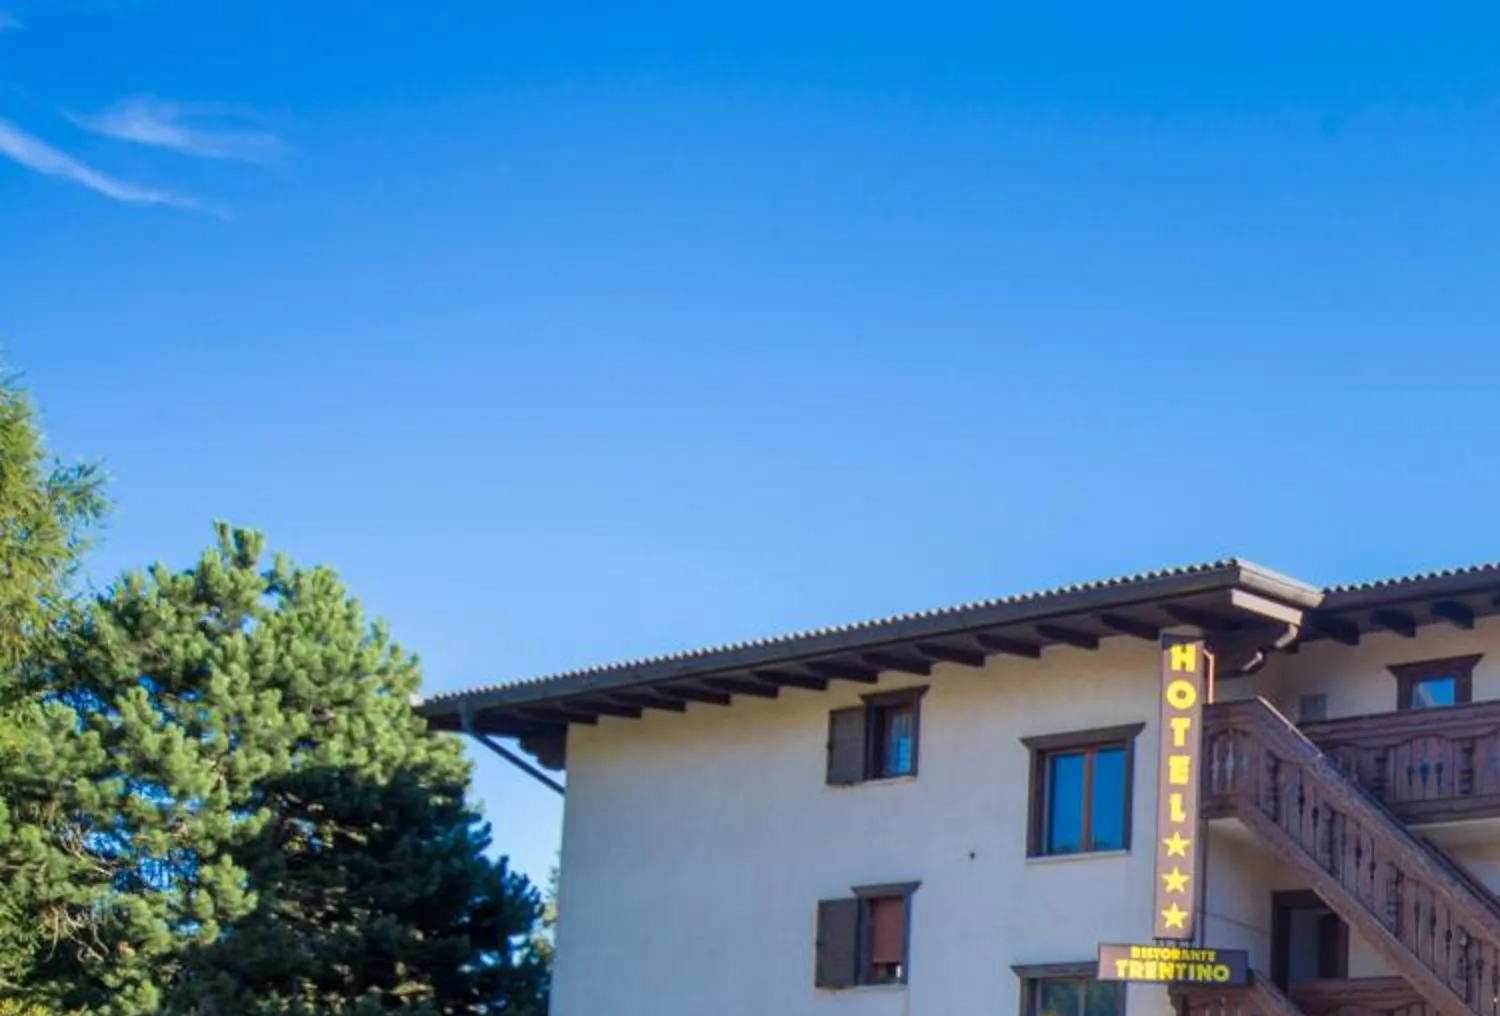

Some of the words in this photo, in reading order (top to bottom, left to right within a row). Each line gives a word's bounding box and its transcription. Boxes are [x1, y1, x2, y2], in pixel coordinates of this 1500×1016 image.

[1166, 643, 1197, 823] HOTEL
[1130, 945, 1216, 962] RISTORANTE
[1115, 959, 1230, 982] TRENTINO
